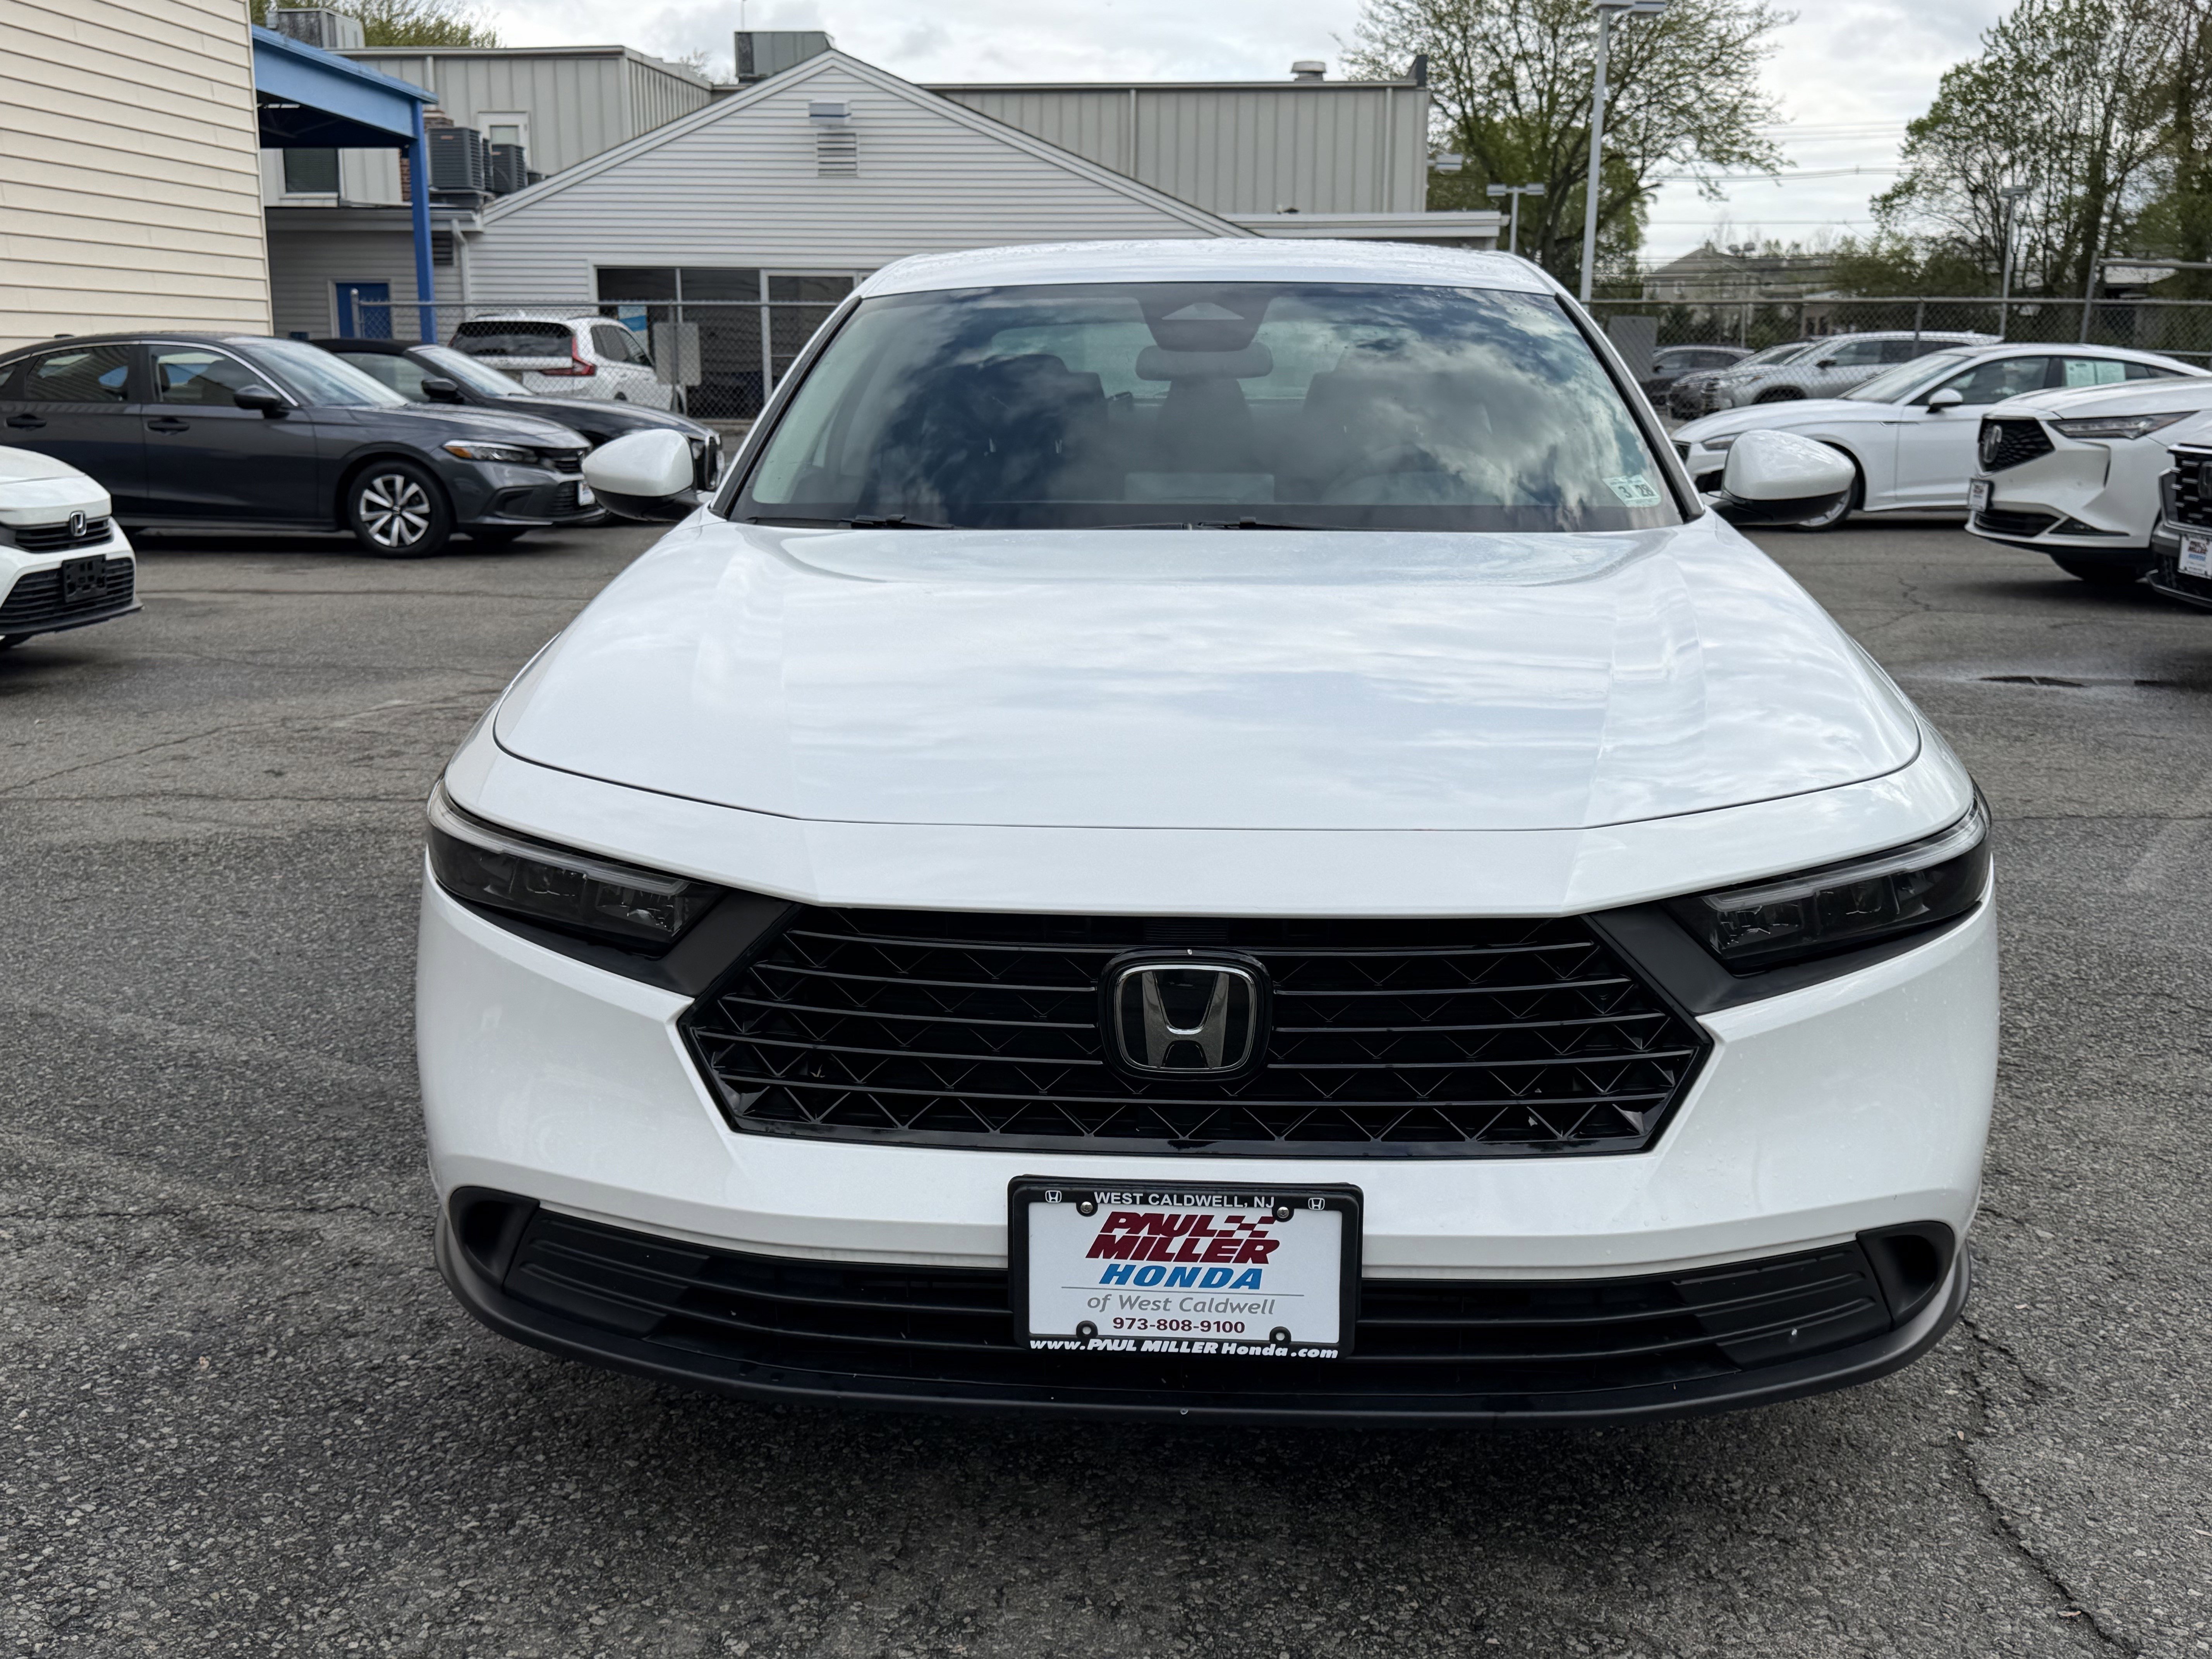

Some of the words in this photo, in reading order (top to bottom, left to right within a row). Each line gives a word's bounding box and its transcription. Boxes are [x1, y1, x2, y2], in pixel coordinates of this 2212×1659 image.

[1618, 486, 1632, 498] 3
[1635, 484, 1656, 497] 28
[1094, 1192, 1143, 1205] WEST
[1148, 1194, 1248, 1208] CALDWELL,
[1254, 1196, 1274, 1208] NJ
[1101, 1212, 1217, 1238] PAUL
[1086, 1234, 1280, 1264] MILLER
[1099, 1264, 1263, 1290] HONDA
[1087, 1293, 1112, 1313] of
[1119, 1295, 1172, 1312] West
[1179, 1297, 1275, 1315] Caldwell
[1113, 1317, 1245, 1333] 973-808-9100
[1140, 1340, 1218, 1354] MILLER
